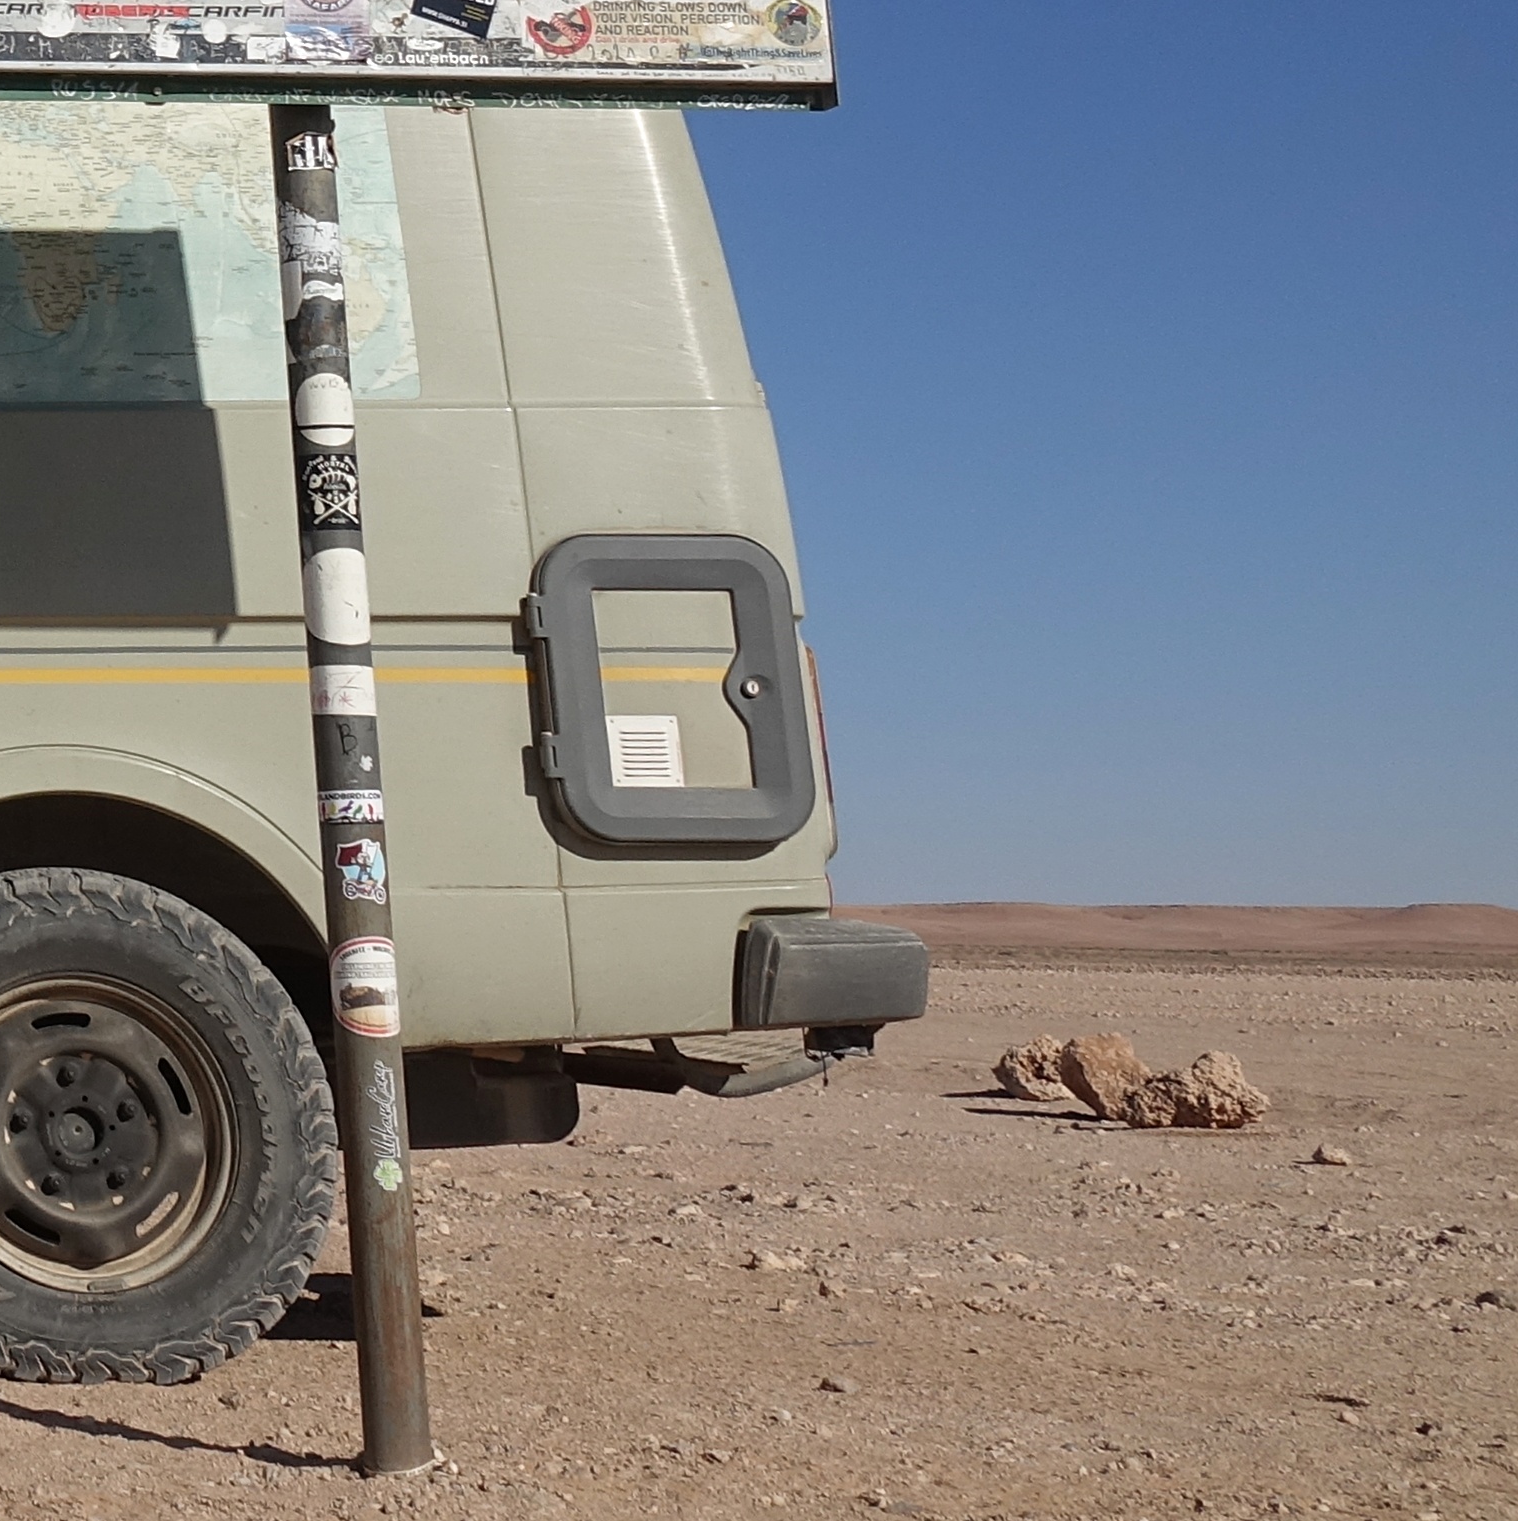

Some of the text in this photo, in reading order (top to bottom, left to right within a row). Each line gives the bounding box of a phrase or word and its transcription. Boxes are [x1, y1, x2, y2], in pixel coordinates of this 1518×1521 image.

[593, 0, 747, 13] DRINKING SLOWS DOWN
[594, 12, 628, 24] YOUR
[595, 24, 623, 36] AND
